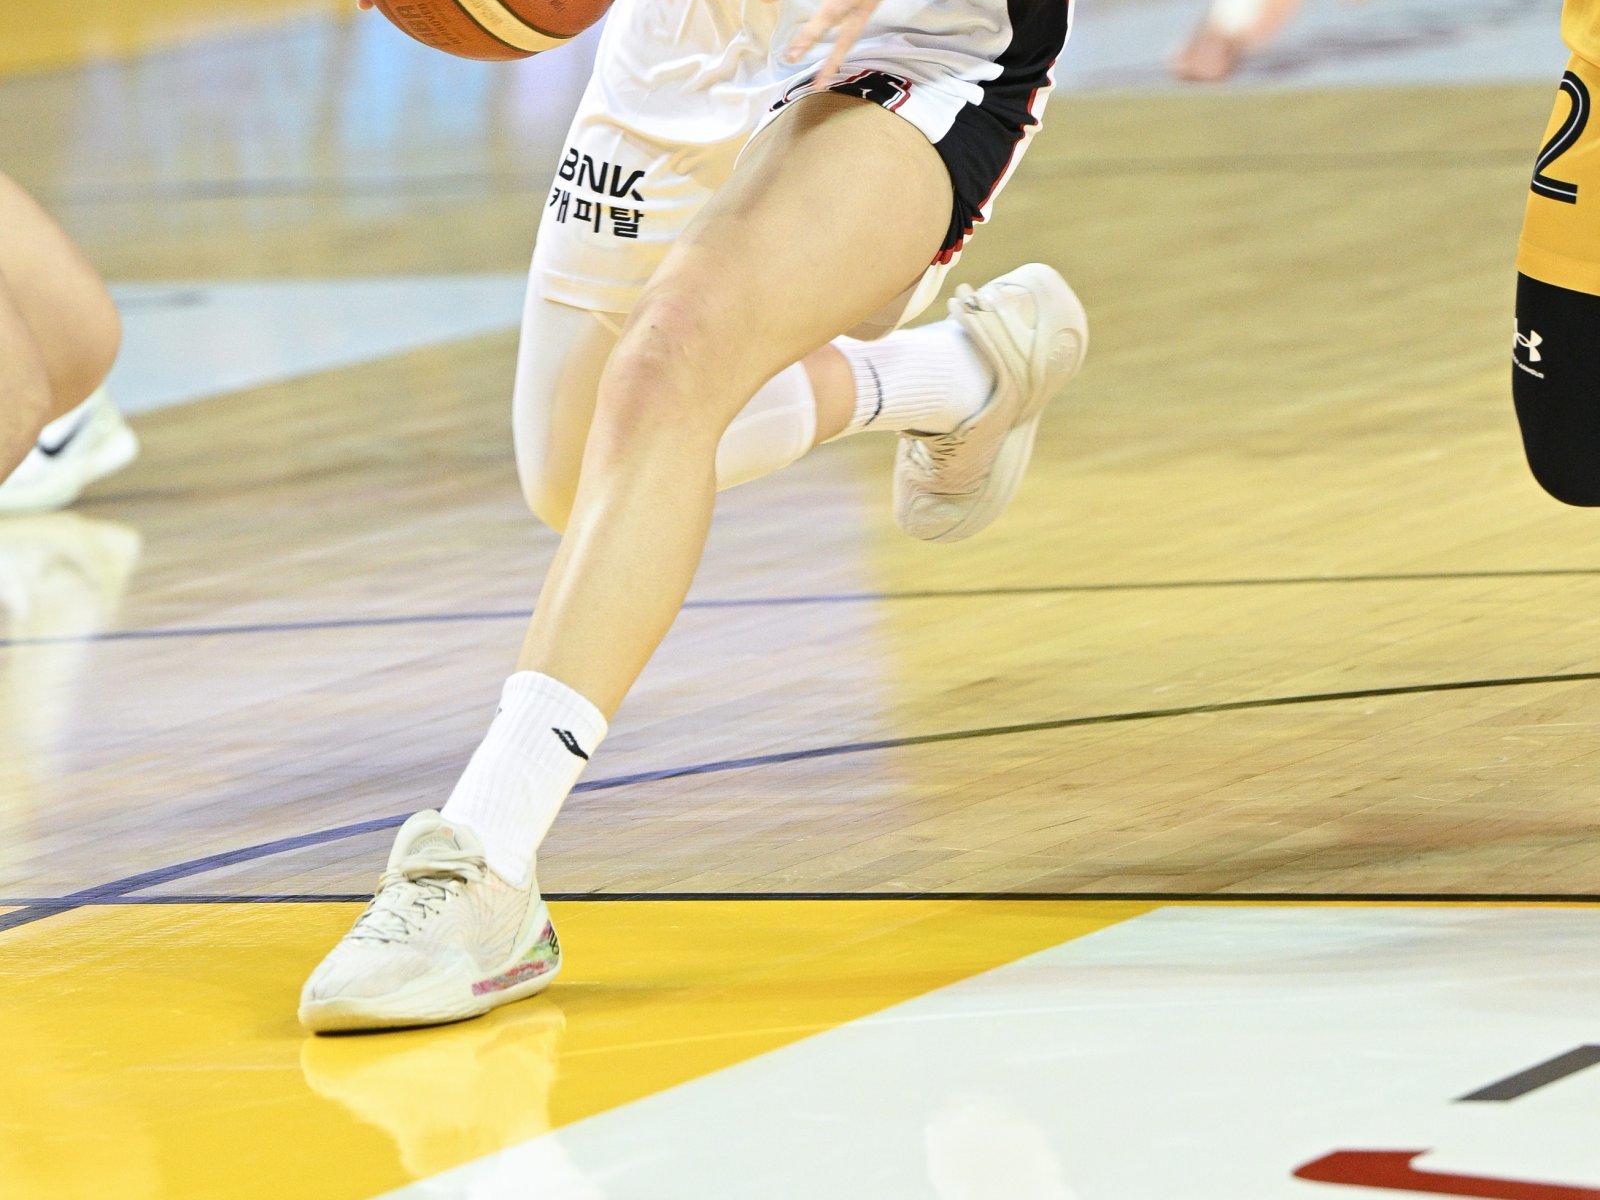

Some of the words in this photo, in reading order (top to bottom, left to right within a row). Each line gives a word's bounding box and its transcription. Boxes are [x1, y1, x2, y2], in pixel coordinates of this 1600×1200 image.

[1530, 70, 1591, 205] 2
[559, 147, 645, 202] BNK
[549, 187, 644, 239] 캐피탈
